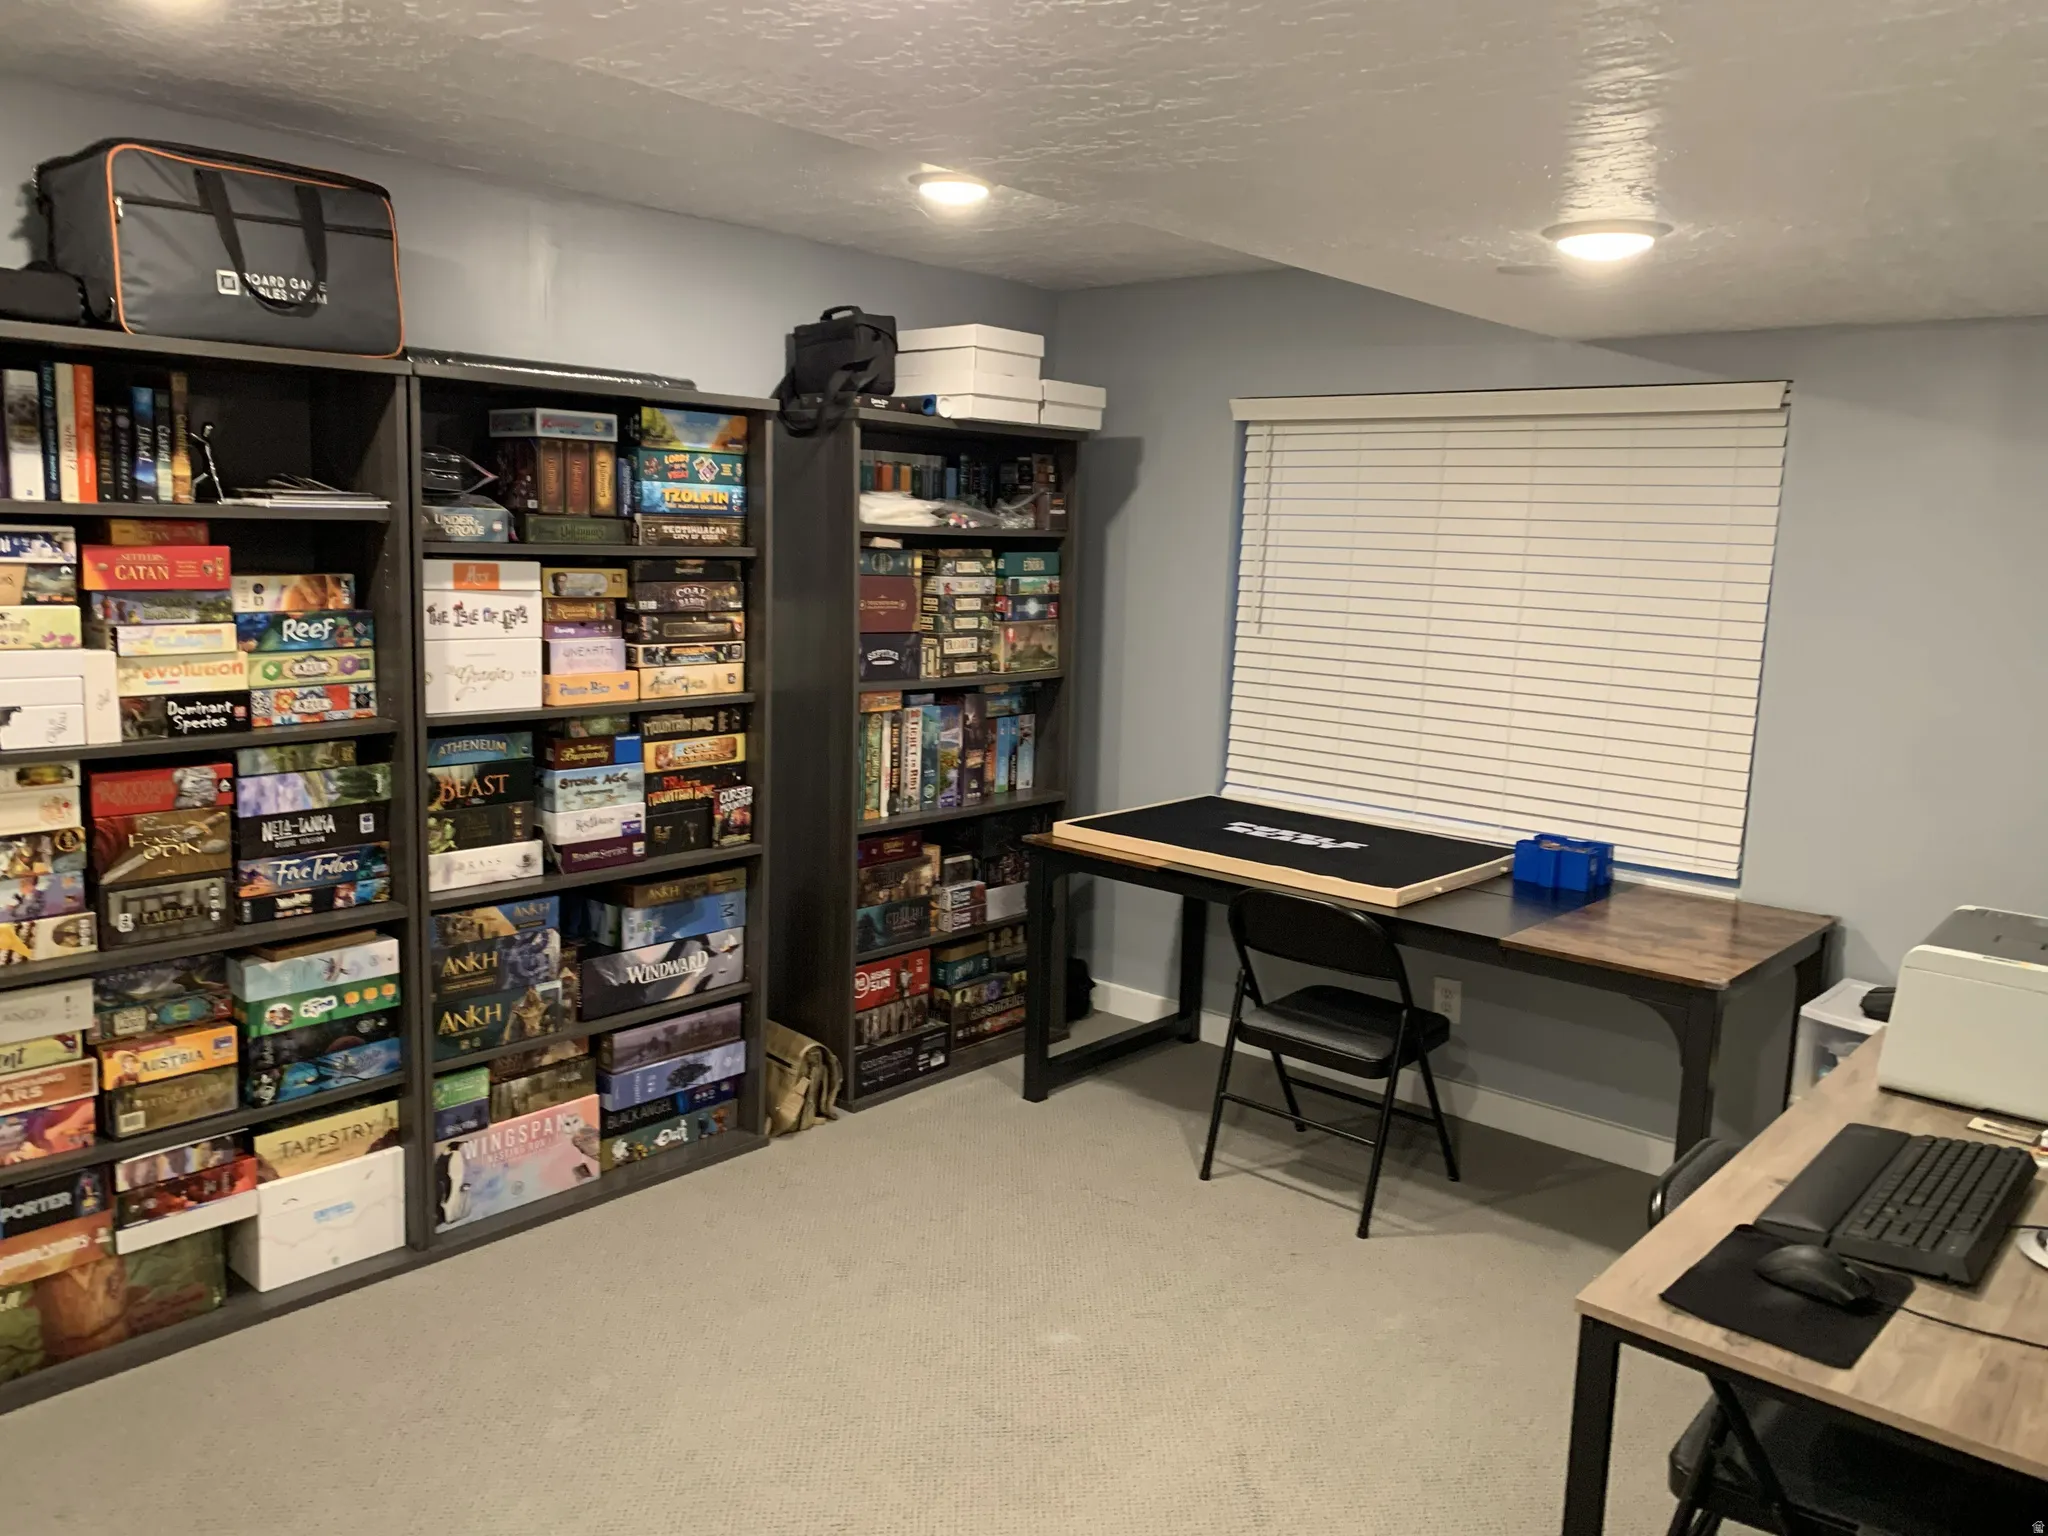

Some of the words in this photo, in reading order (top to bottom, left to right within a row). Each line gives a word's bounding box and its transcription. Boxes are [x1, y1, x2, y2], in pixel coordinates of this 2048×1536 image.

[289, 277, 328, 292] GAE
[445, 525, 485, 537] GROVE
[114, 564, 170, 581] CATAN
[167, 701, 234, 716] Dominant
[172, 714, 229, 735] Species
[437, 738, 507, 759] ATHENEUM
[438, 773, 511, 803] BEAST
[441, 951, 499, 978] ANKH
[626, 950, 710, 984] WINDWARD
[437, 1003, 502, 1036] ANKH
[278, 1121, 378, 1160] TAPESTRY
